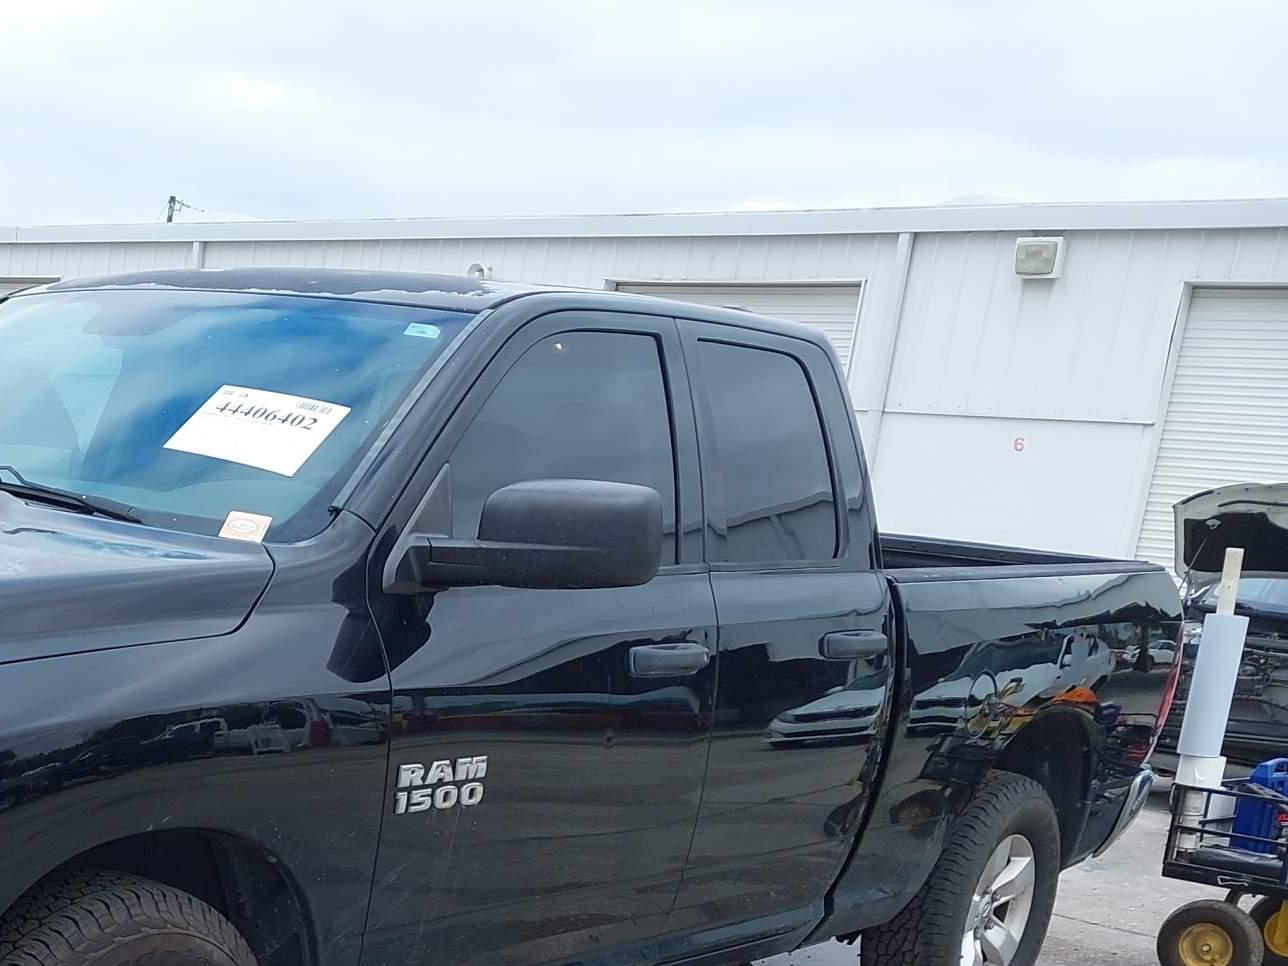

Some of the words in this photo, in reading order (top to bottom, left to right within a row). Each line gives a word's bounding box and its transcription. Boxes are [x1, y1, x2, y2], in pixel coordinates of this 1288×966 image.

[215, 401, 318, 431] 44406402
[1014, 437, 1025, 452] 6
[397, 755, 488, 788] RAM
[395, 782, 484, 815] 1500
